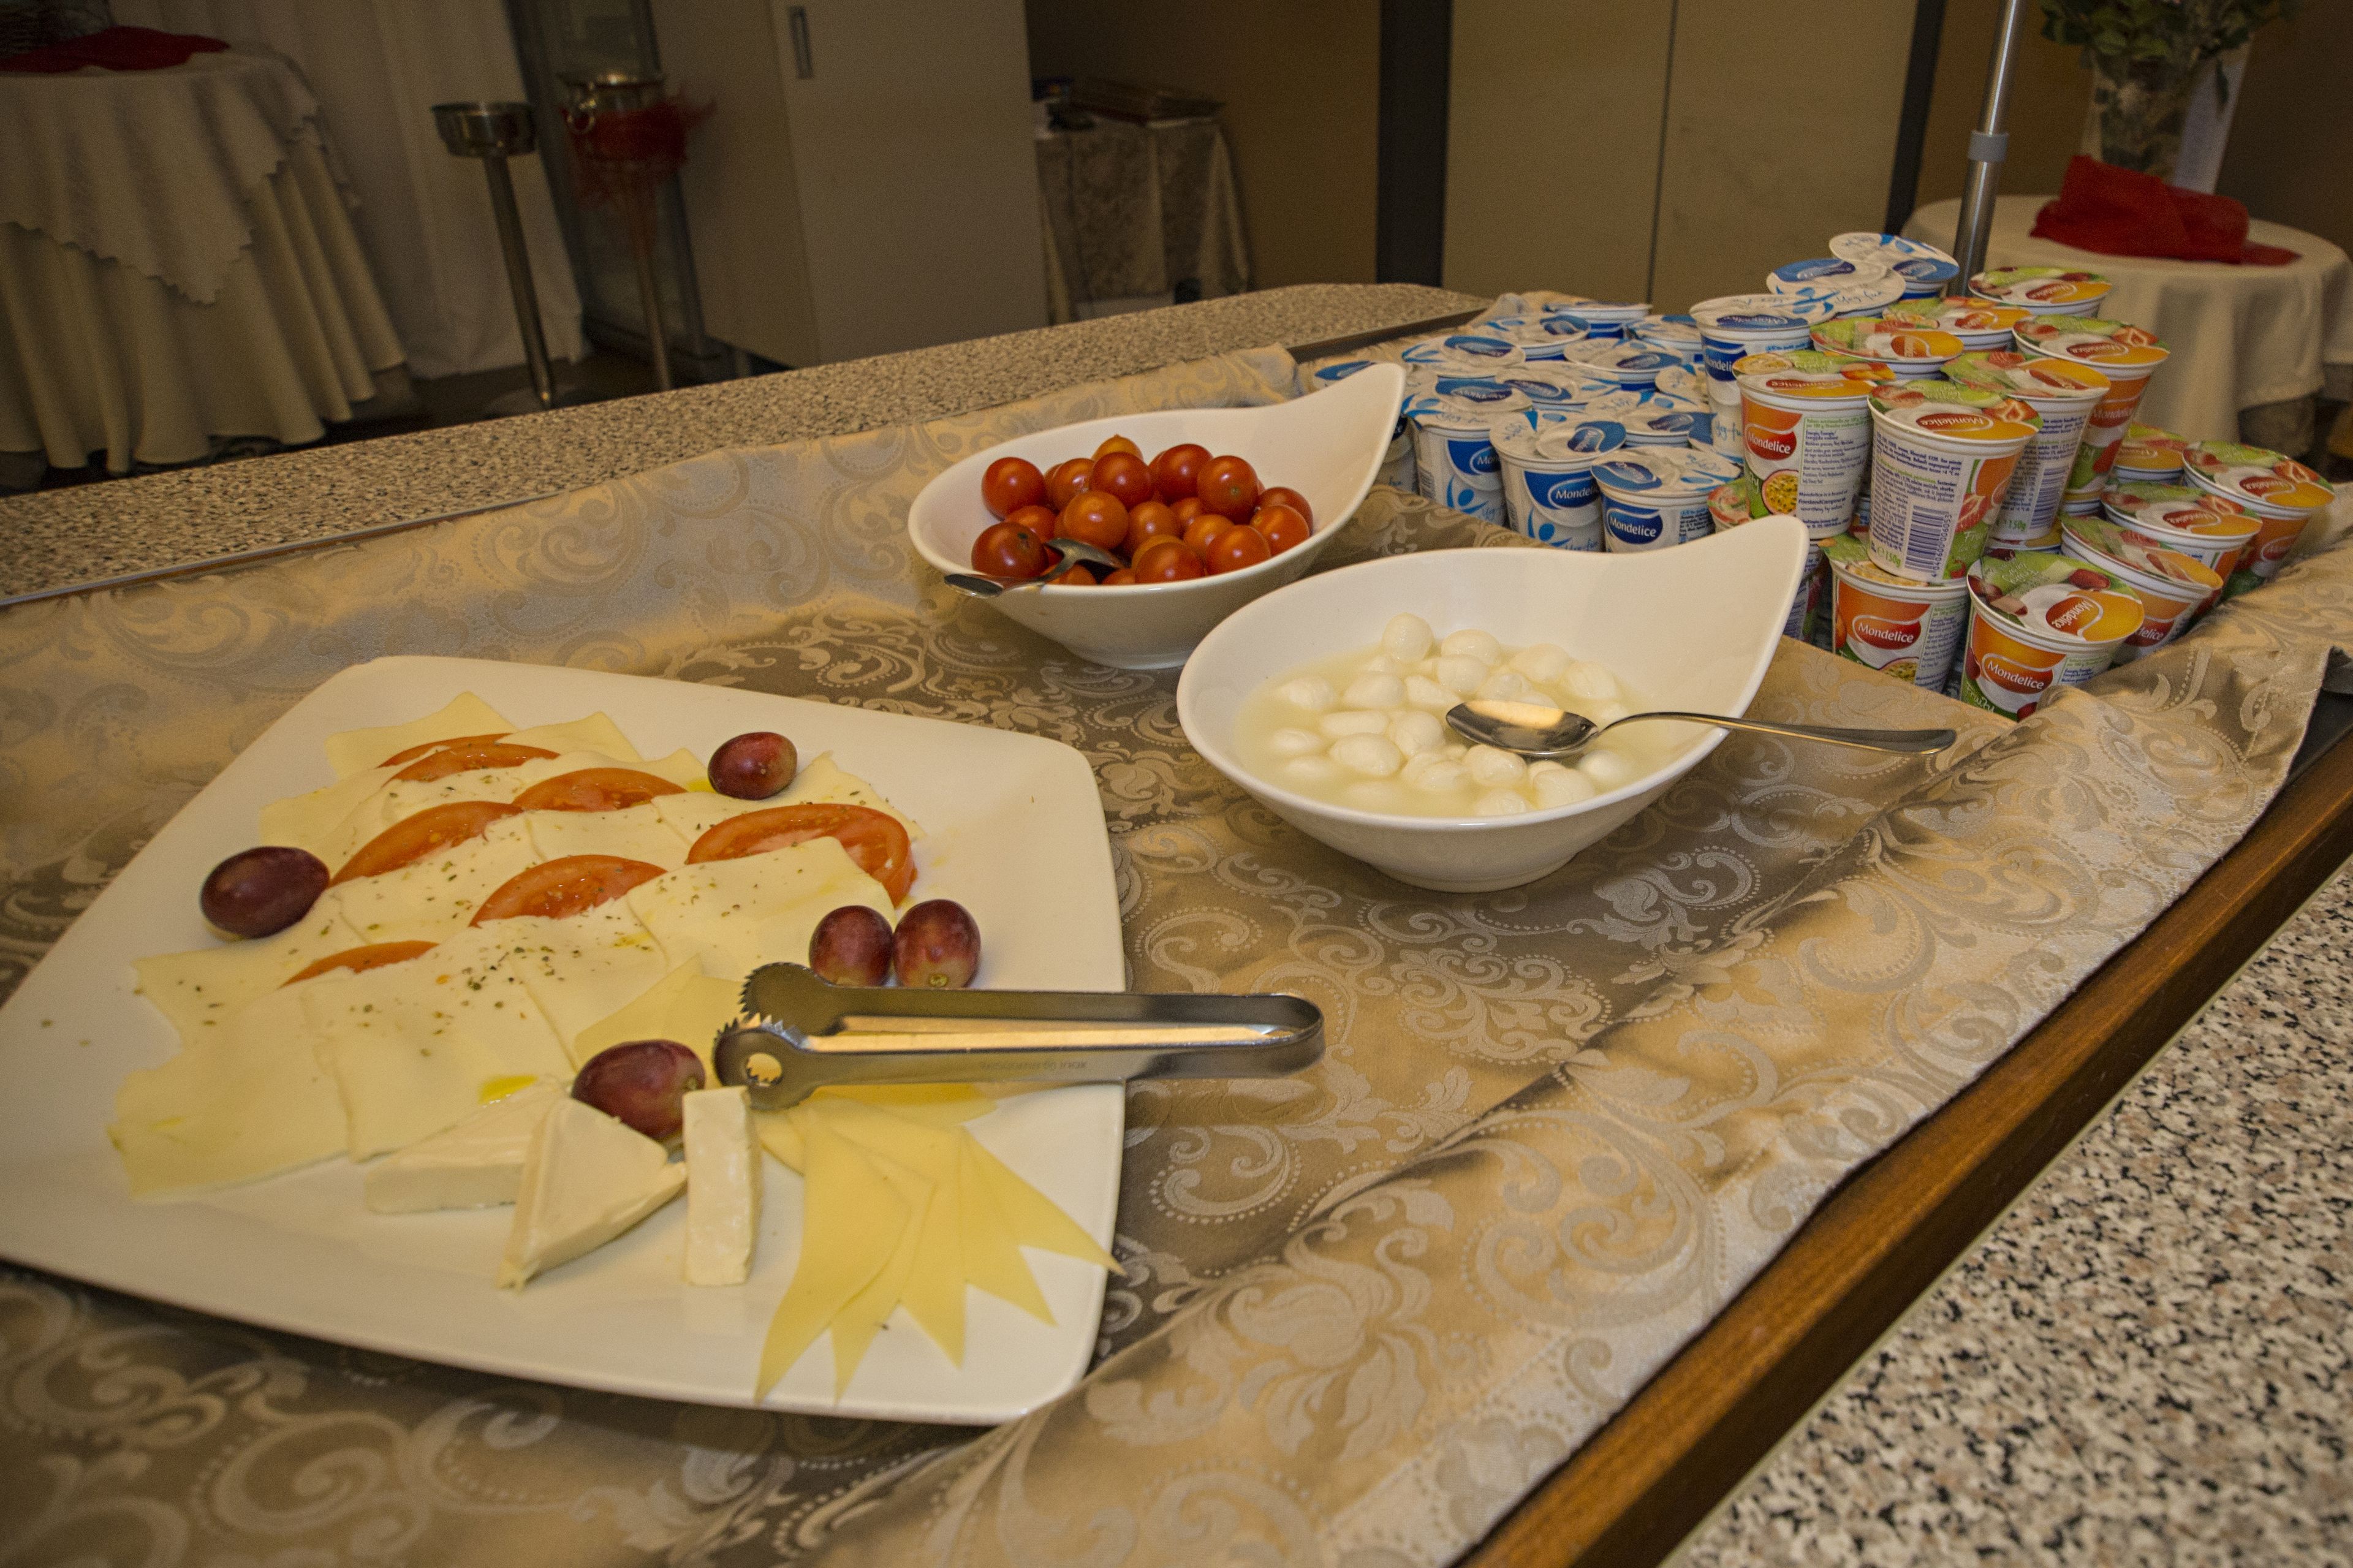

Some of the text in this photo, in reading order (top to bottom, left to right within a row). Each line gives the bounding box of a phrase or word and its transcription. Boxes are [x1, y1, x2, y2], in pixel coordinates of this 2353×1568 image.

[1922, 416, 1985, 426] Mondelice
[1748, 431, 1791, 455] Mondelice
[1555, 482, 1596, 500] Mondel
[1610, 516, 1657, 537] Mondelice
[2052, 597, 2094, 629] Mondelice
[1858, 621, 1914, 643] Mondelice
[1987, 661, 2045, 691] Mondelice
